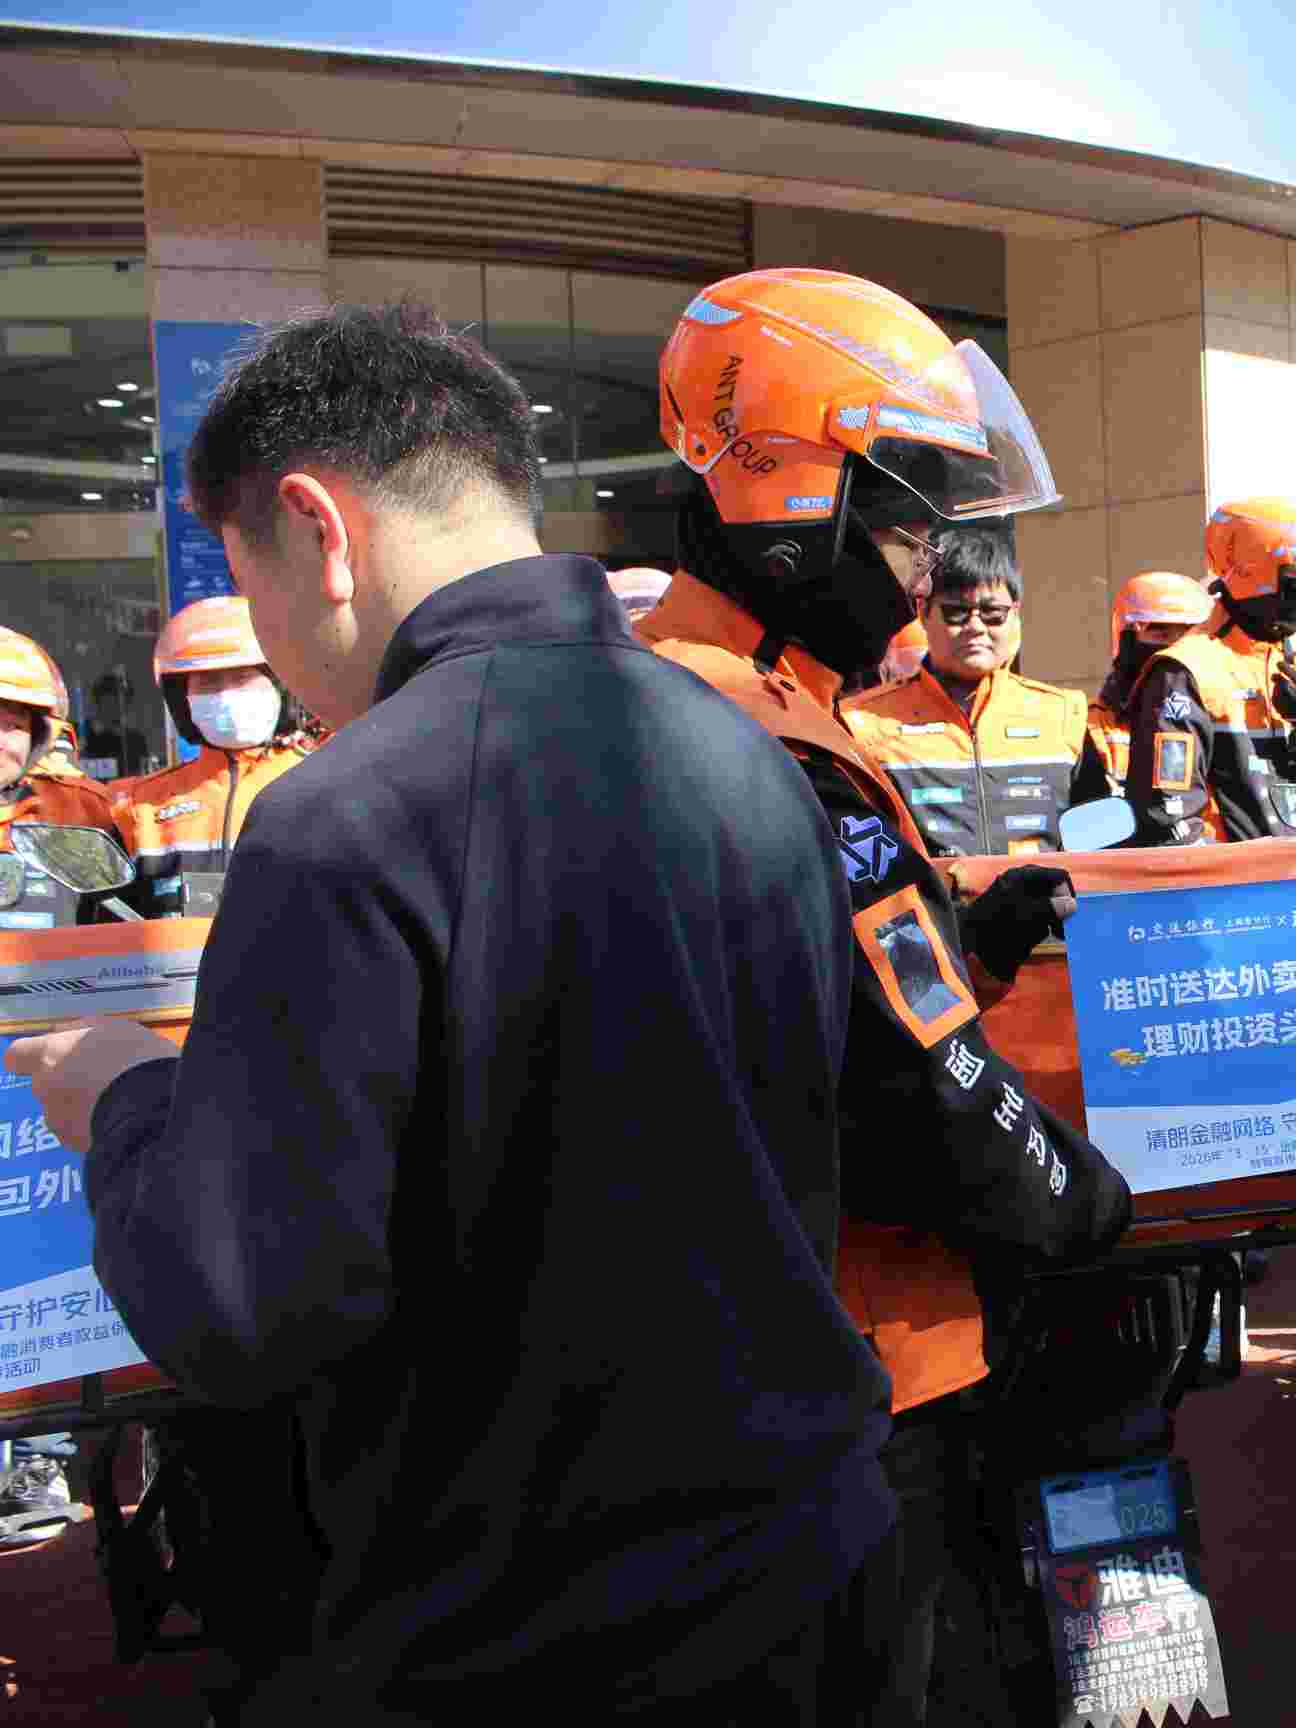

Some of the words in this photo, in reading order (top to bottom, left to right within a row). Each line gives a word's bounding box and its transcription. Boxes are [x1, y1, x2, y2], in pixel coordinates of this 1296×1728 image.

[714, 354, 743, 401] ANT
[712, 407, 777, 475] GROUP
[1145, 1115, 1275, 1152] 清朗金融网络
[1097, 1546, 1187, 1606] 雅迪
